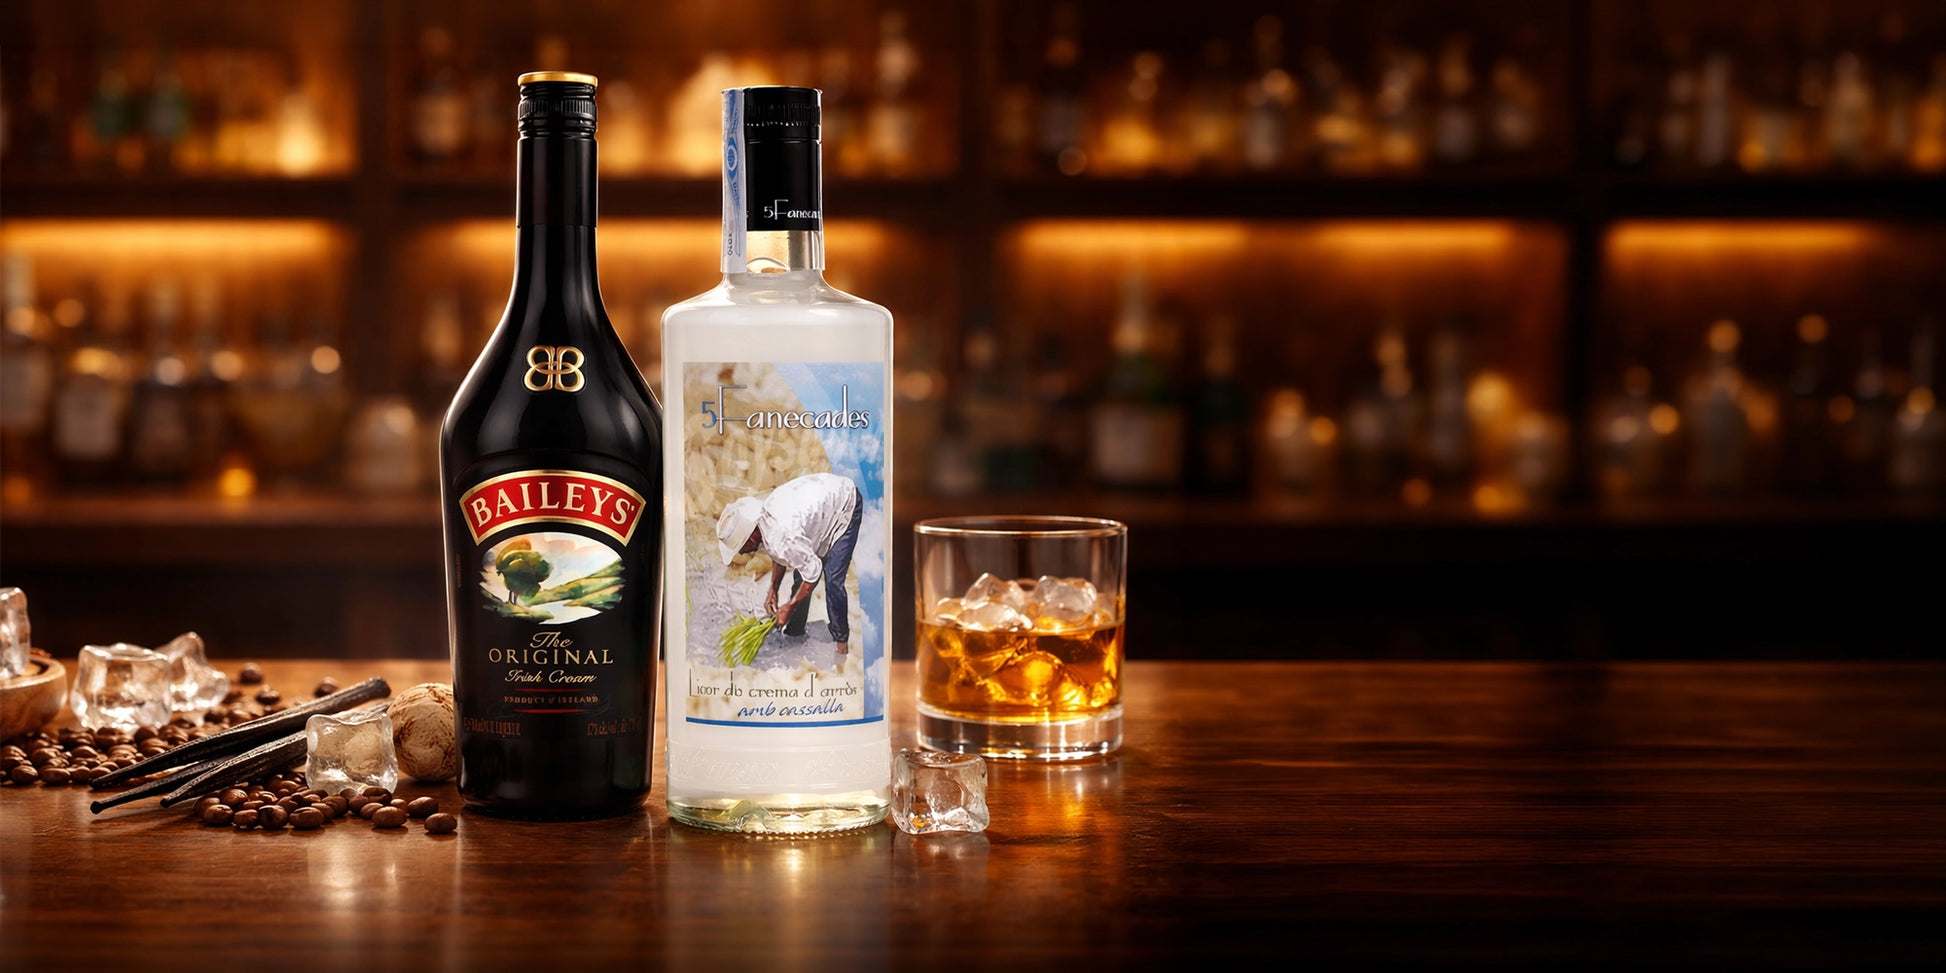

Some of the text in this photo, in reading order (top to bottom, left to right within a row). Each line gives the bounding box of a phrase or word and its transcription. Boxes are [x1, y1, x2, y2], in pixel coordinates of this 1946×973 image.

[529, 631, 573, 648] The
[488, 648, 614, 665] ORIGINAL
[748, 687, 799, 698] crema
[737, 700, 776, 718] amb
